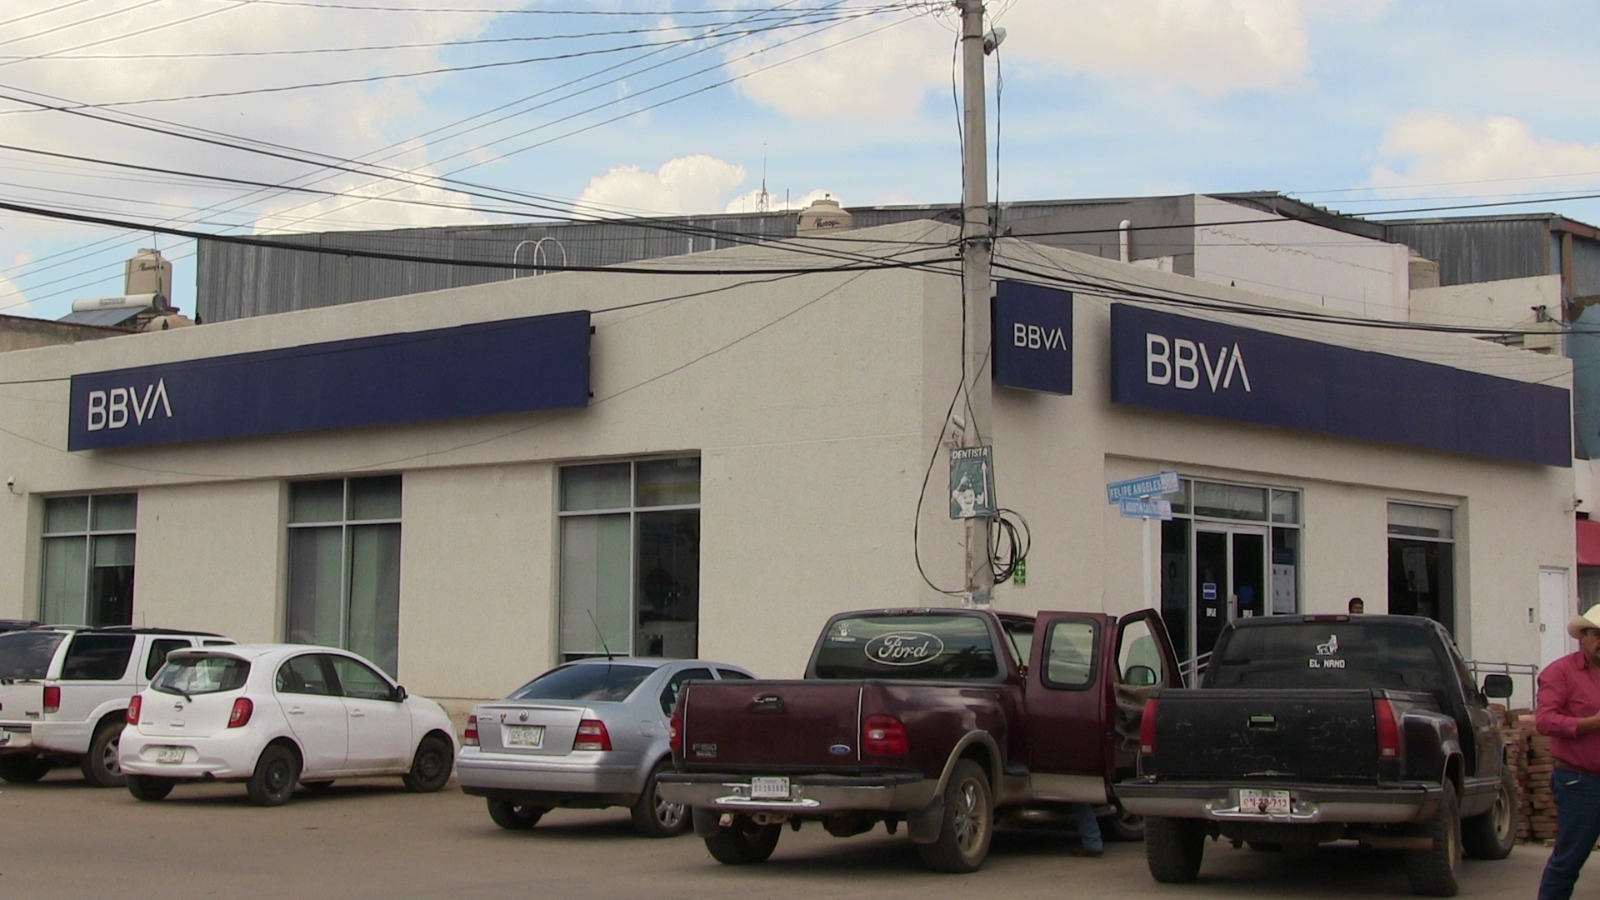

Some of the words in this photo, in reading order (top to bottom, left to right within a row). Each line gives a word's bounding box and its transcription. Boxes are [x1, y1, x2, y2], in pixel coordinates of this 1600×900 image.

[1014, 322, 1067, 351] BBVA
[1146, 333, 1251, 393] BBVA
[87, 377, 173, 432] BBVA
[952, 447, 988, 460] DENTISTA
[1110, 485, 1131, 498] FELIPE
[878, 635, 930, 659] Ford
[1309, 659, 1320, 668] EL
[1323, 659, 1346, 669] NANO
